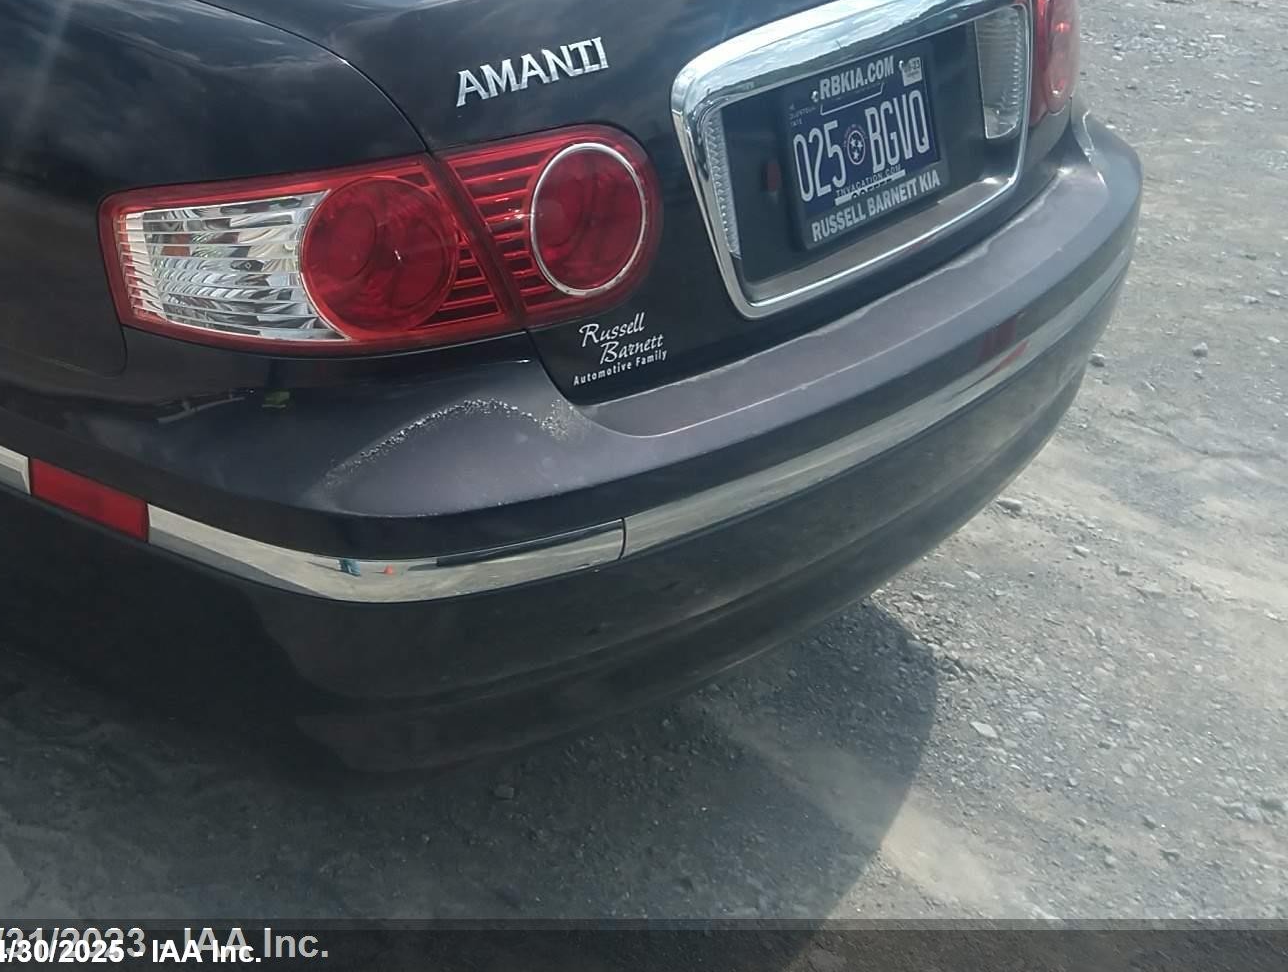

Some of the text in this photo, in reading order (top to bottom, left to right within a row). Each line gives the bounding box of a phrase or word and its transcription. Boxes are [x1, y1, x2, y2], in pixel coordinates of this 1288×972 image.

[456, 36, 609, 108] AMANTI
[819, 55, 895, 100] RBKIA.COM
[793, 119, 847, 202] 025
[811, 169, 941, 242] RUSSELL BARNETT KIA
[578, 312, 645, 348] Russell
[599, 333, 664, 365] Barnett
[573, 349, 668, 386] Automotive Family
